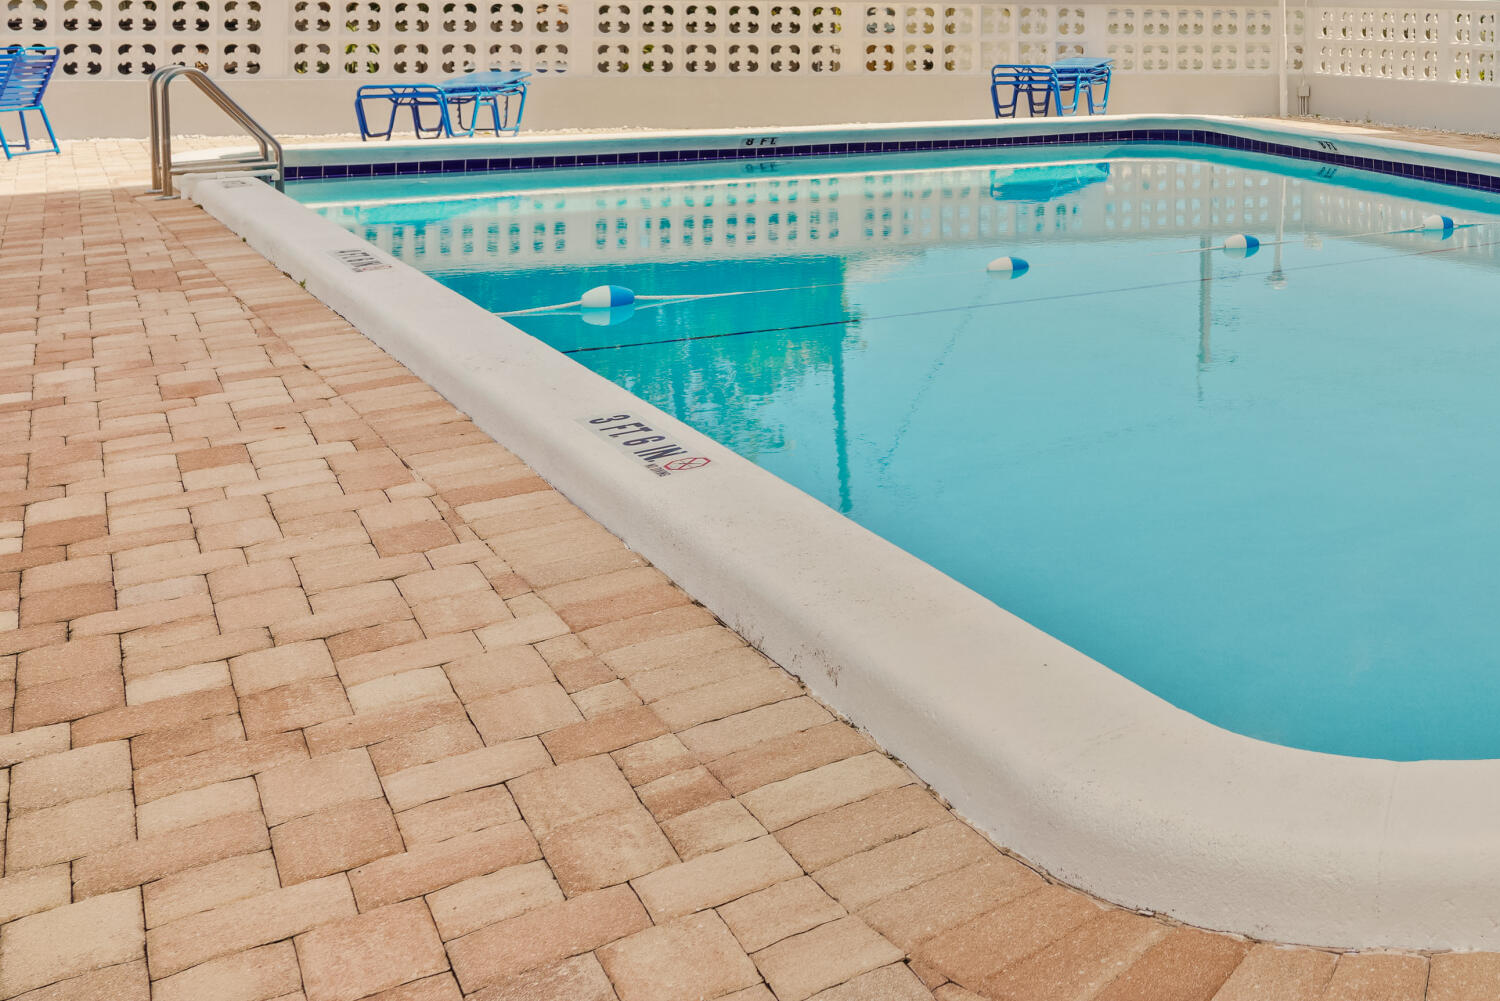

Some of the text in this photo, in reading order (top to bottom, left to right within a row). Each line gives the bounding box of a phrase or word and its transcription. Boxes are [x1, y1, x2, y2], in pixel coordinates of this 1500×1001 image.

[588, 414, 688, 462] 3 FT. 6 IN.
